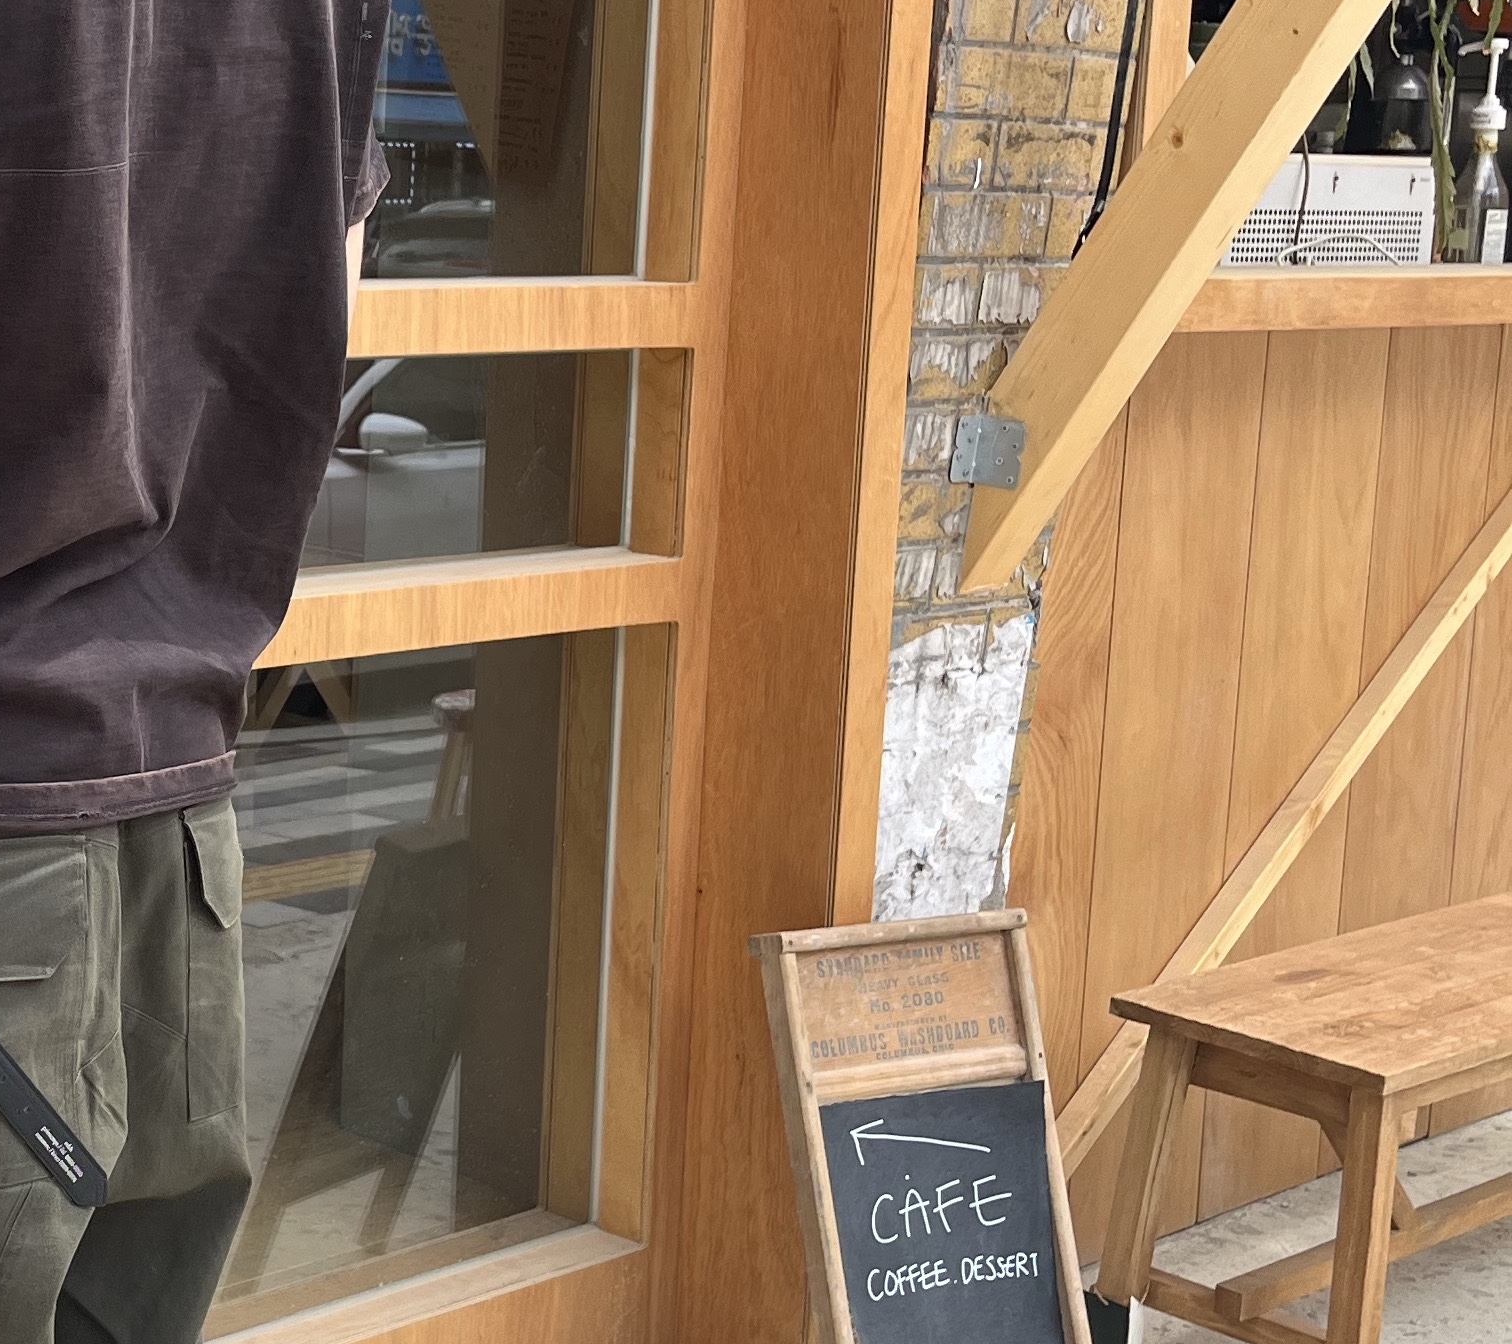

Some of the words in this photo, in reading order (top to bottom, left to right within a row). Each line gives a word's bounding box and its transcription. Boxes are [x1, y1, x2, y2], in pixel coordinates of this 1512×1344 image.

[816, 952, 889, 978] STANDARD
[950, 941, 981, 962] SIZE
[870, 997, 895, 1014] No.
[810, 1033, 888, 1059] COLUMBUS
[897, 1019, 980, 1048] WASHBOARD
[989, 1016, 1010, 1035] CO.
[870, 1174, 1013, 1244] CAFE
[960, 1252, 1039, 1285] DESSERT
